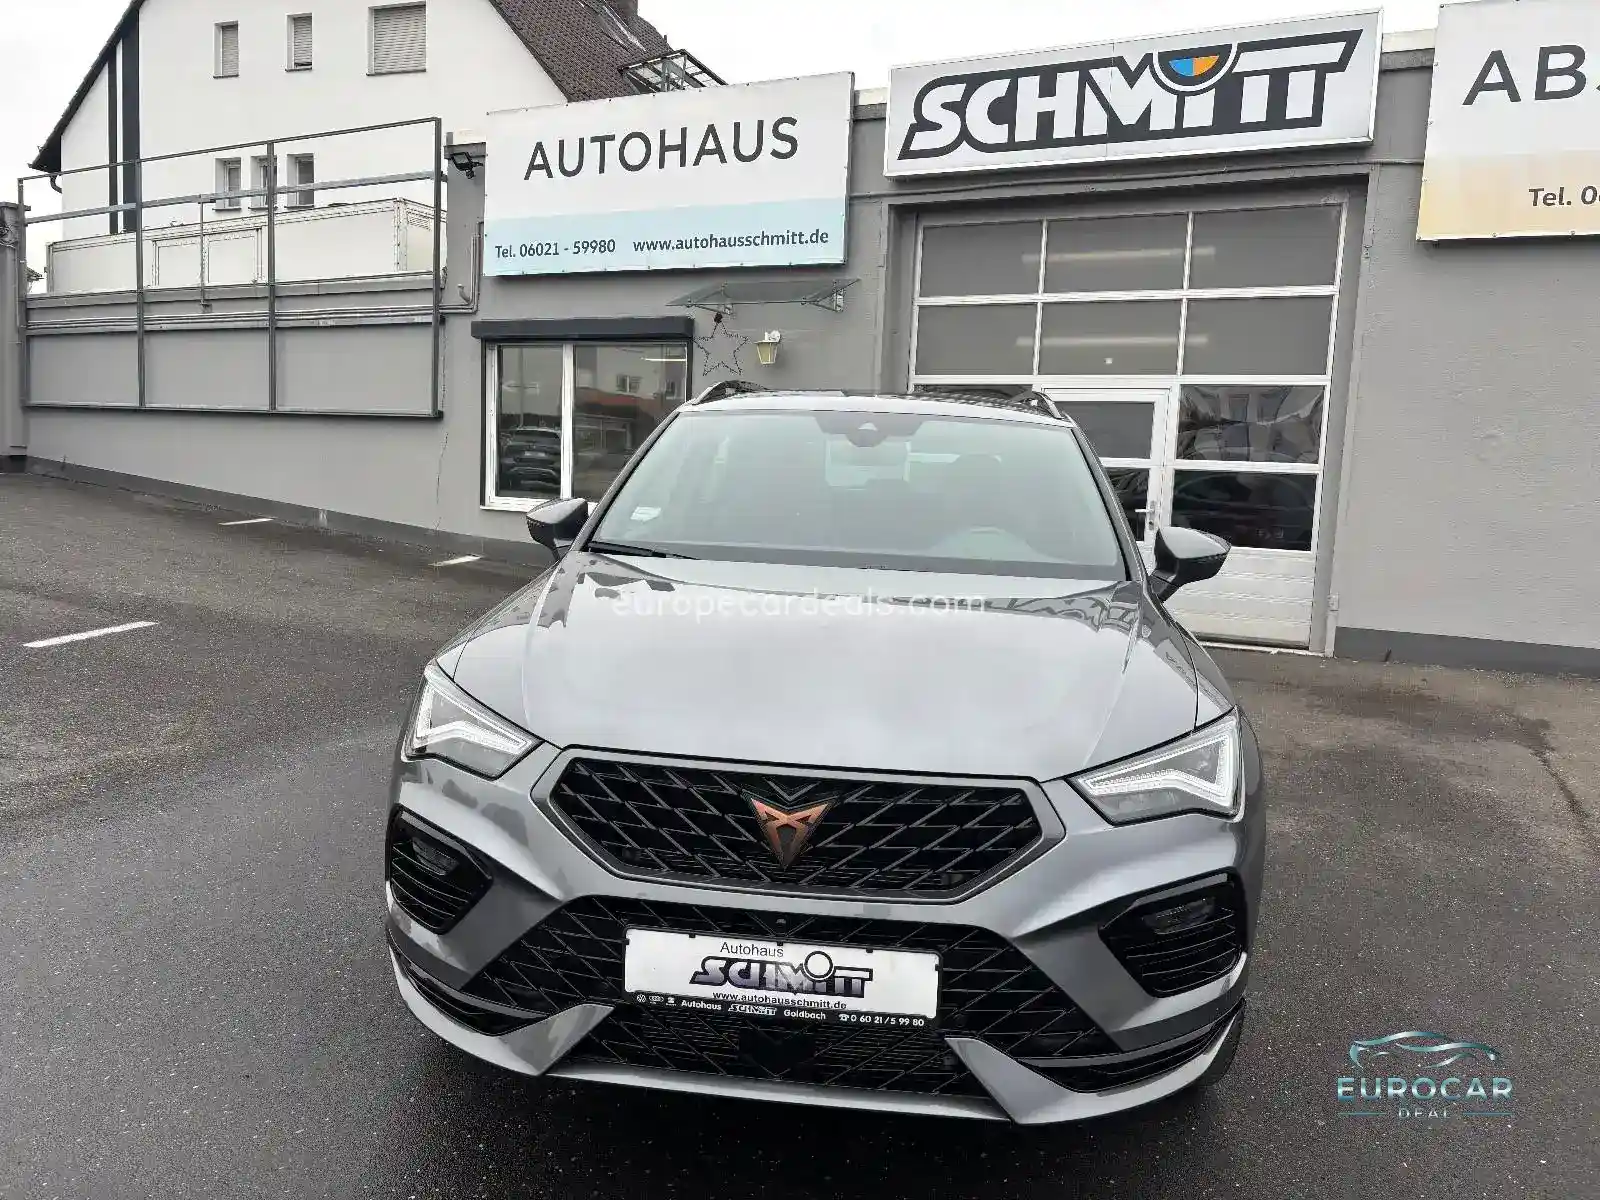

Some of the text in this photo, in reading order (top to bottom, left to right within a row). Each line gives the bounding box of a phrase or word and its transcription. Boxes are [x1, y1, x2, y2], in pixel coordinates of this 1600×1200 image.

[1462, 44, 1600, 106] AB
[897, 28, 1364, 161] SCHMITT
[523, 116, 799, 181] AUTOHAUS
[1529, 185, 1600, 207] Tel. 0
[494, 244, 517, 258] Tel.
[519, 242, 560, 258] 06021
[572, 239, 616, 255] 59980
[632, 228, 829, 253] www.autohausschmitt.de
[720, 941, 784, 958] Autohaus
[681, 999, 722, 1011] Autohaus
[783, 1009, 826, 1020] Goldbach
[859, 1015, 872, 1023] 60
[898, 1017, 910, 1026] 99
[912, 1018, 925, 1027] 80
[712, 991, 847, 1010] www.autohausschmitt.de
